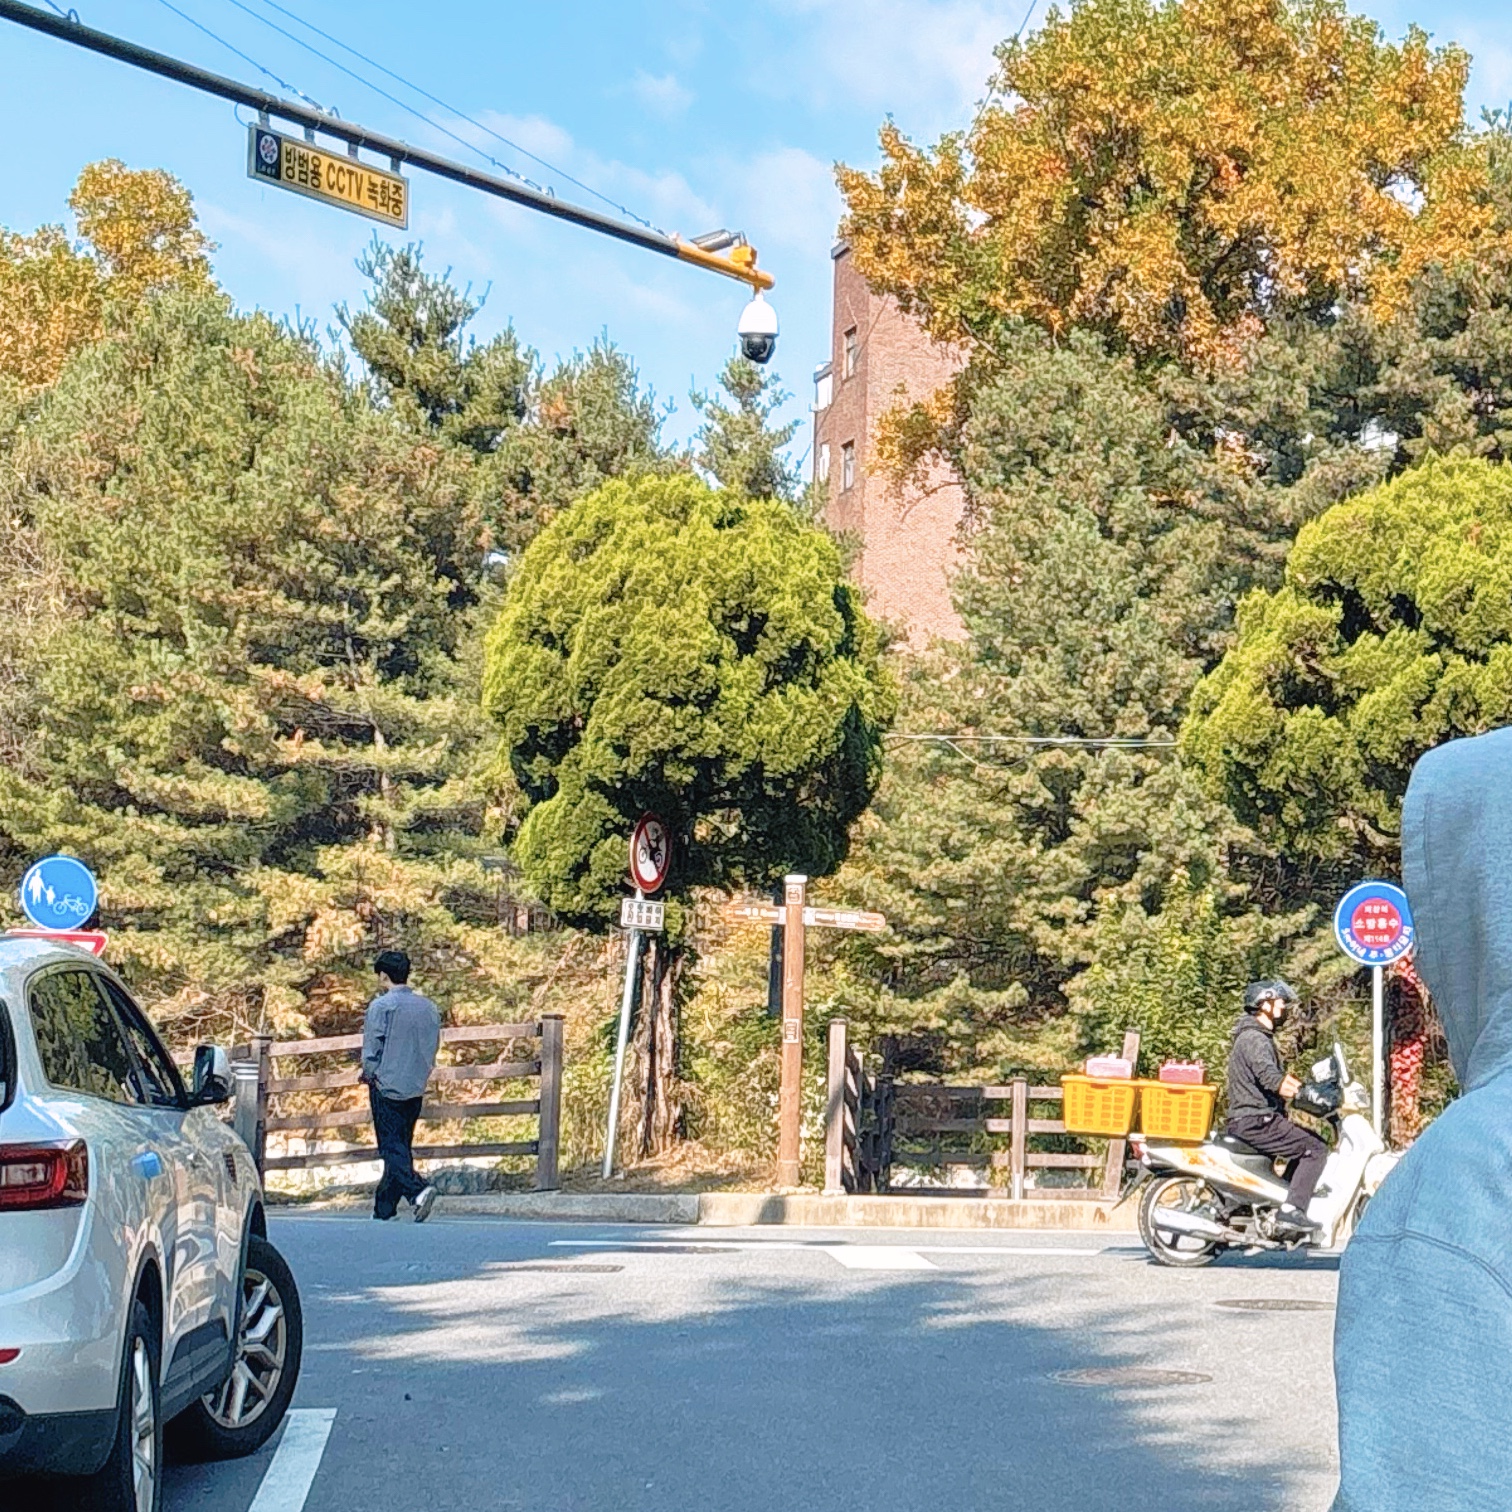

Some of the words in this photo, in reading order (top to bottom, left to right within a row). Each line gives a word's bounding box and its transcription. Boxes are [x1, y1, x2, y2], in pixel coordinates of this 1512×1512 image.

[285, 146, 322, 189] 방범용
[326, 161, 364, 201] CCTV
[367, 175, 404, 217] 녹화중
[1354, 917, 1399, 930] 소방용수
